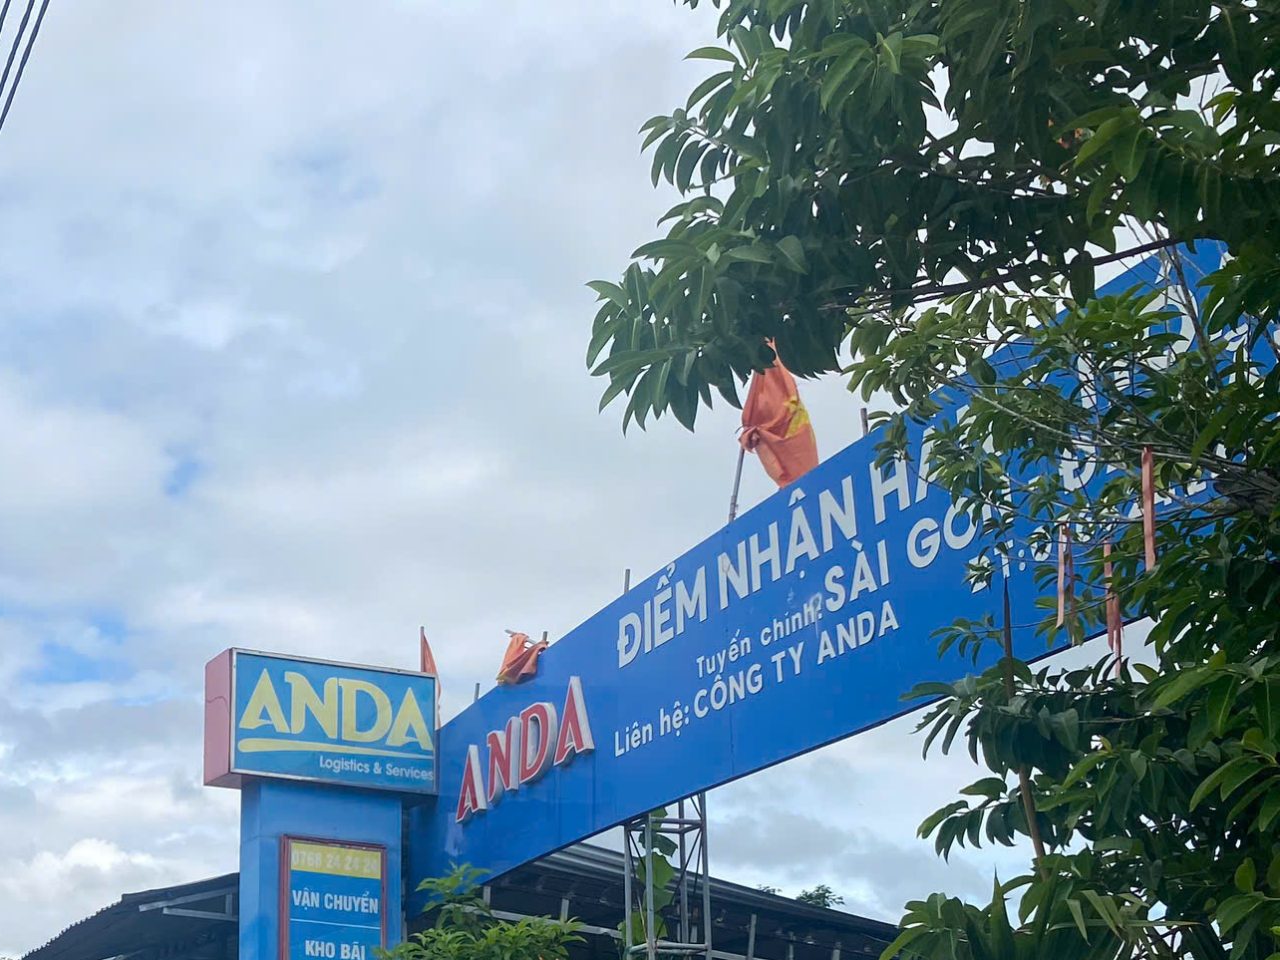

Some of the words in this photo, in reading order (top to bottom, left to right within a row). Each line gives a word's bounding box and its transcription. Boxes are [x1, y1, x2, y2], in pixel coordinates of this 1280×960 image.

[617, 562, 708, 668] ĐIỂM
[717, 475, 858, 611] NHẬN
[696, 628, 752, 679] Tuyến
[824, 540, 891, 613] SÀI
[239, 667, 434, 750] ANDA
[614, 722, 654, 758] Liên
[659, 702, 691, 738] hệ:
[693, 662, 764, 720] CÔNG
[771, 641, 806, 684] TY
[816, 600, 901, 666] ANDA
[319, 755, 370, 775] Logistics
[373, 760, 383, 775] &
[385, 763, 434, 782] Services
[455, 675, 595, 824] ANDA
[291, 887, 320, 911] VẬN
[323, 891, 379, 914] CHUYỂN
[305, 939, 336, 959] KHO
[340, 941, 366, 960] BÃI
